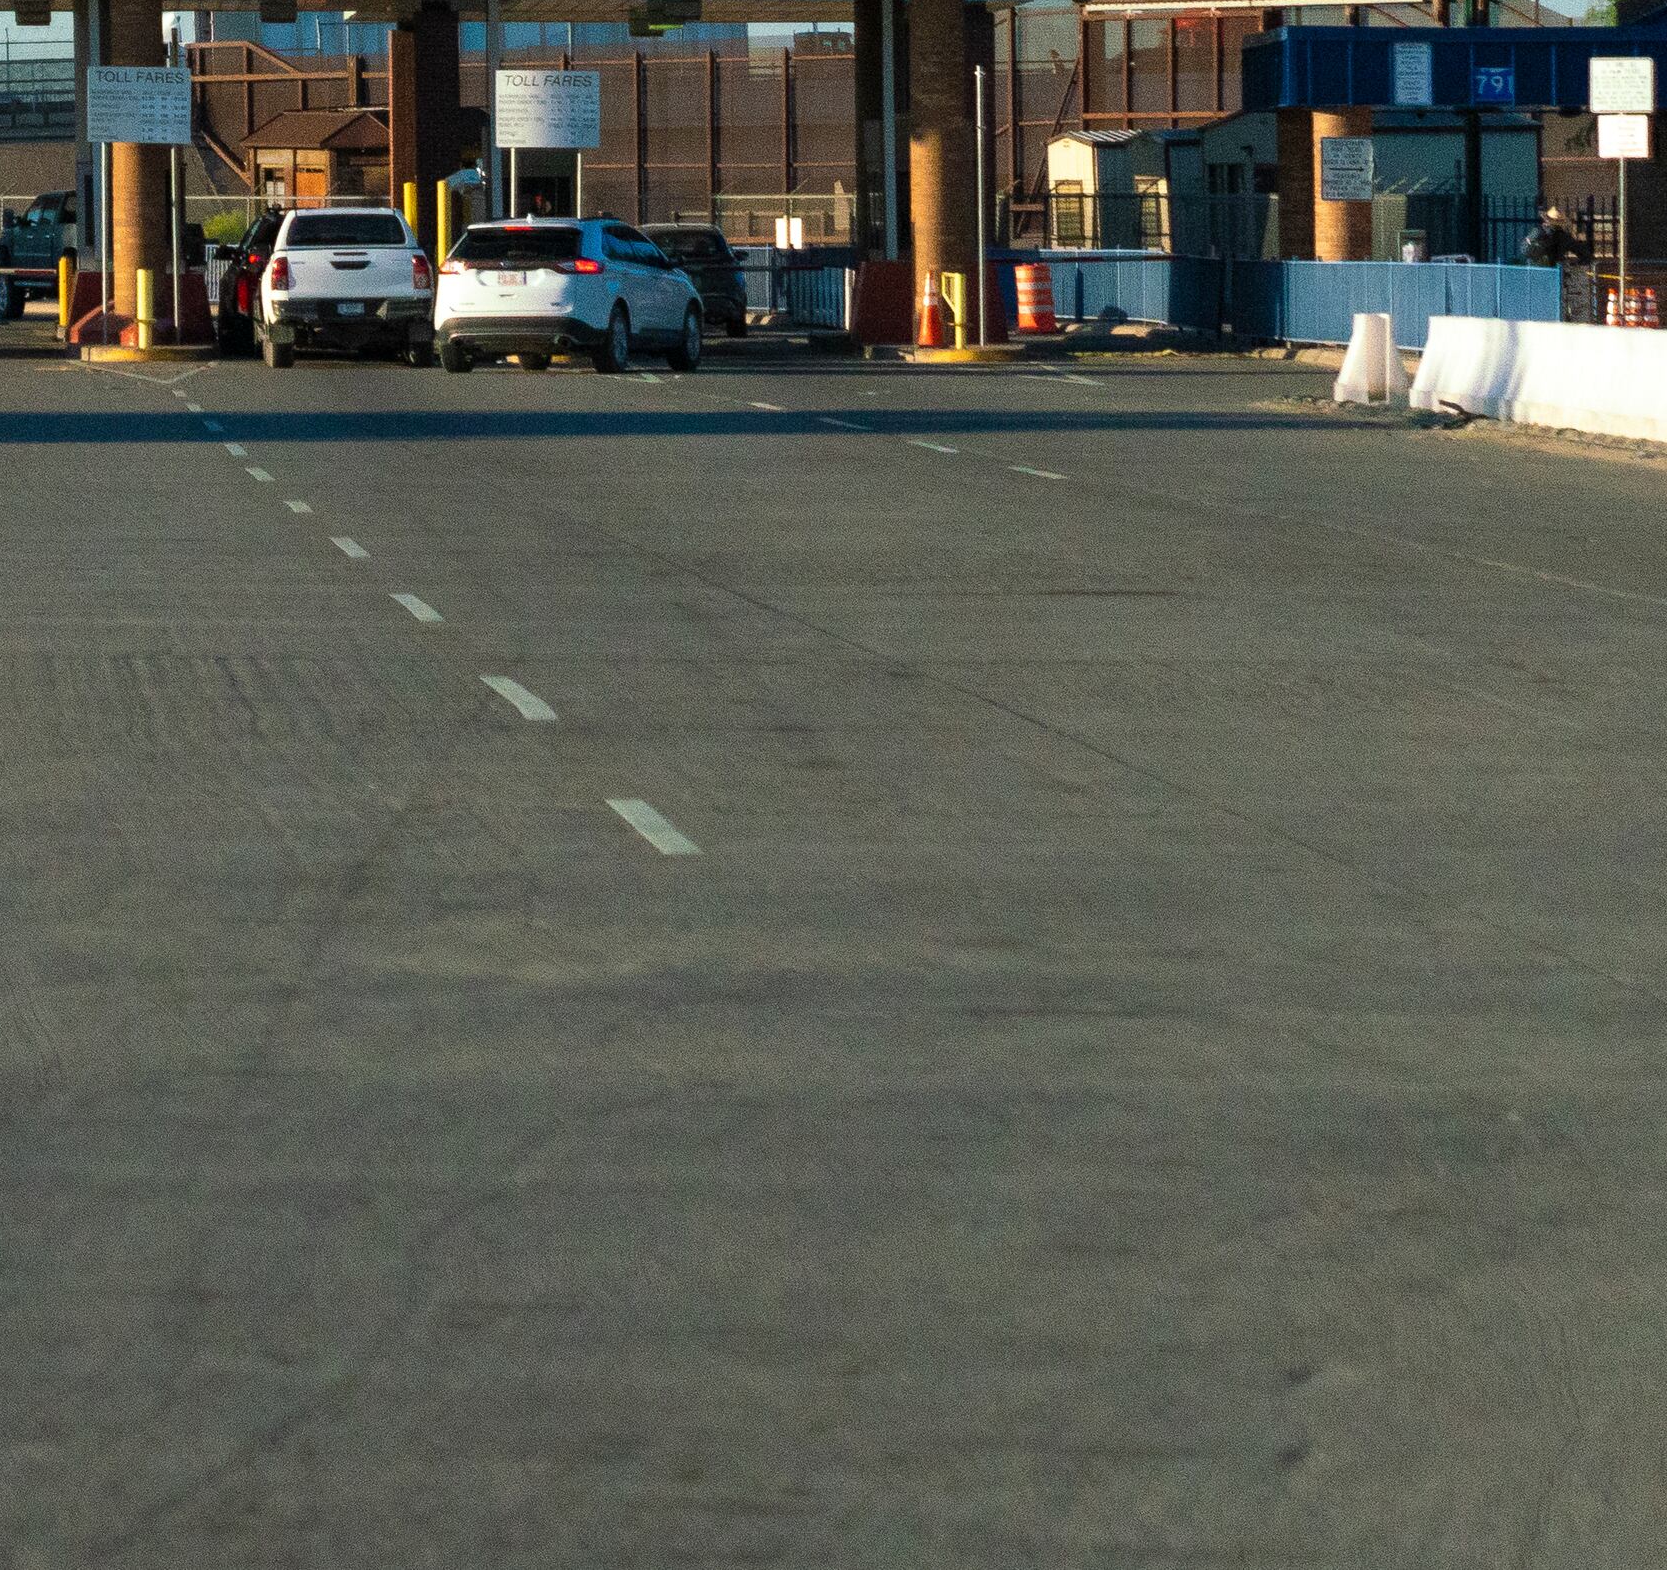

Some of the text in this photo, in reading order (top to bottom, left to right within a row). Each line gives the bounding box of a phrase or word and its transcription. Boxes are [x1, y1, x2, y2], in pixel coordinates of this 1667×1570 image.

[96, 70, 184, 84] TOLL FARES
[505, 75, 593, 87] TOLL FARES
